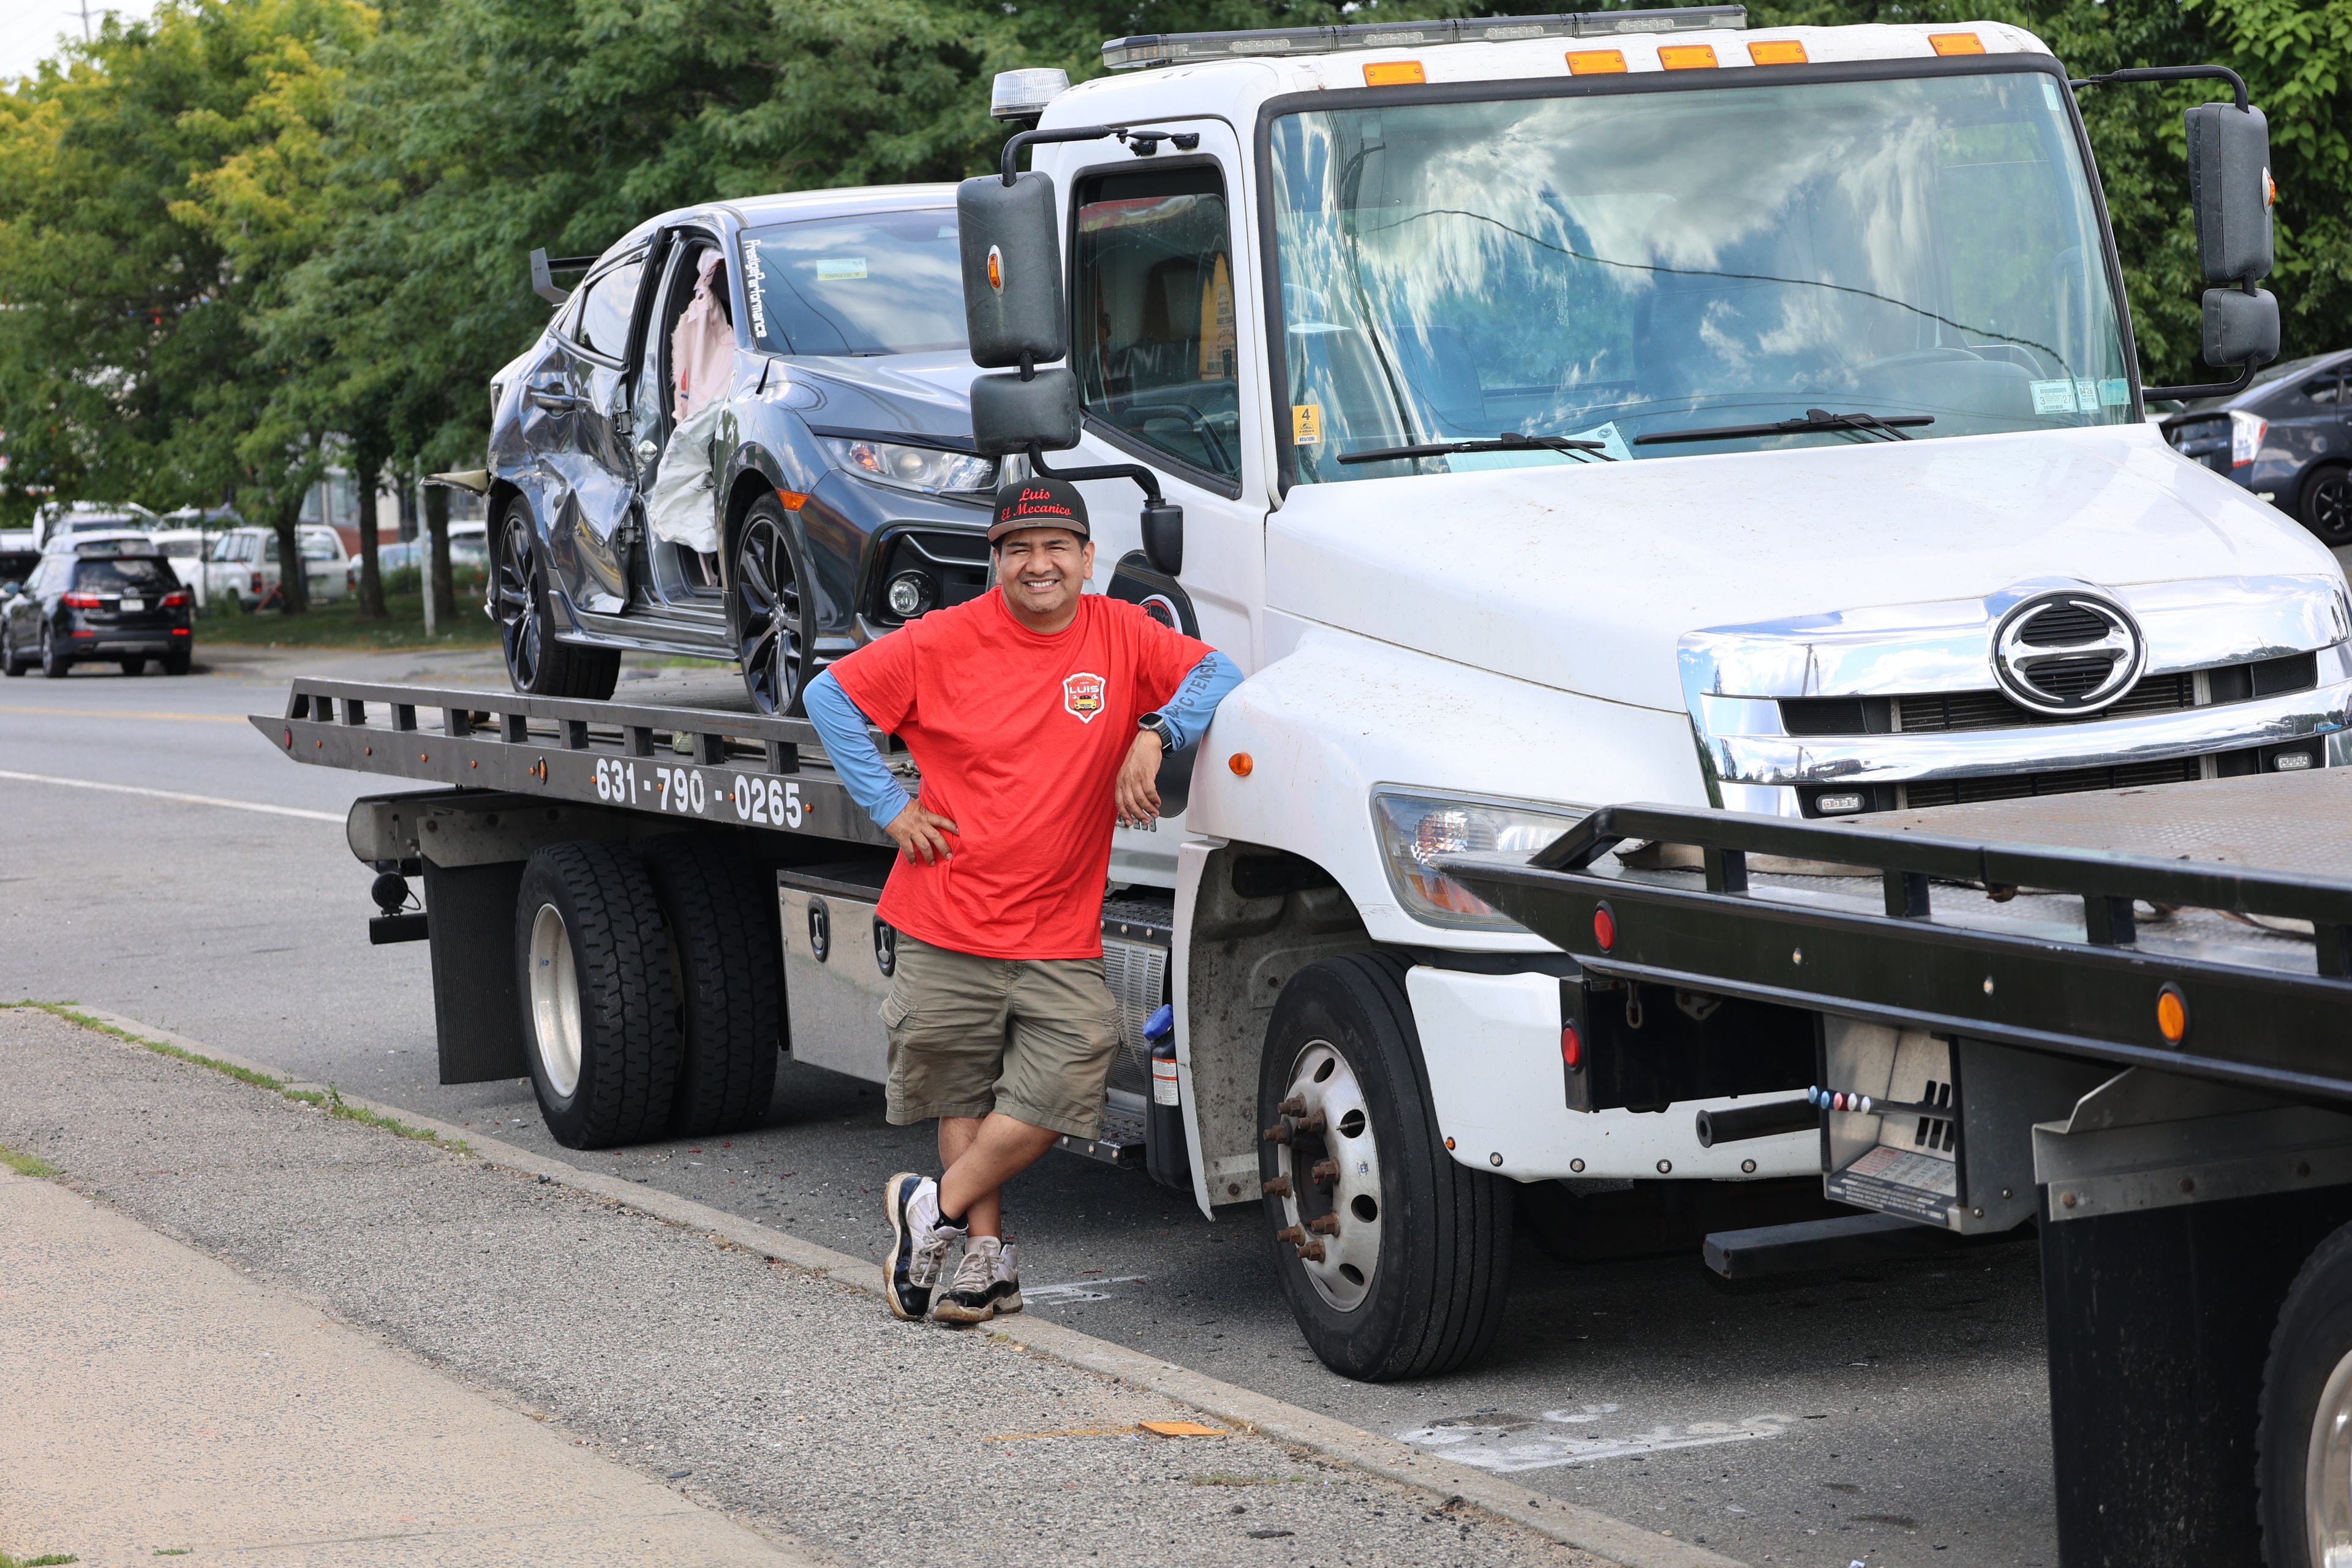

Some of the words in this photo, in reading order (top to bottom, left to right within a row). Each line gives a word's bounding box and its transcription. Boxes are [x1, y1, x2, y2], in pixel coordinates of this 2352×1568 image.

[744, 239, 767, 337] PrestigePerformance
[2040, 396, 2045, 405] 3
[2063, 395, 2071, 404] 27
[1302, 408, 1311, 420] 4
[1019, 488, 1051, 502] Luis
[1001, 507, 1011, 521] El
[1012, 503, 1072, 516] Mecanico
